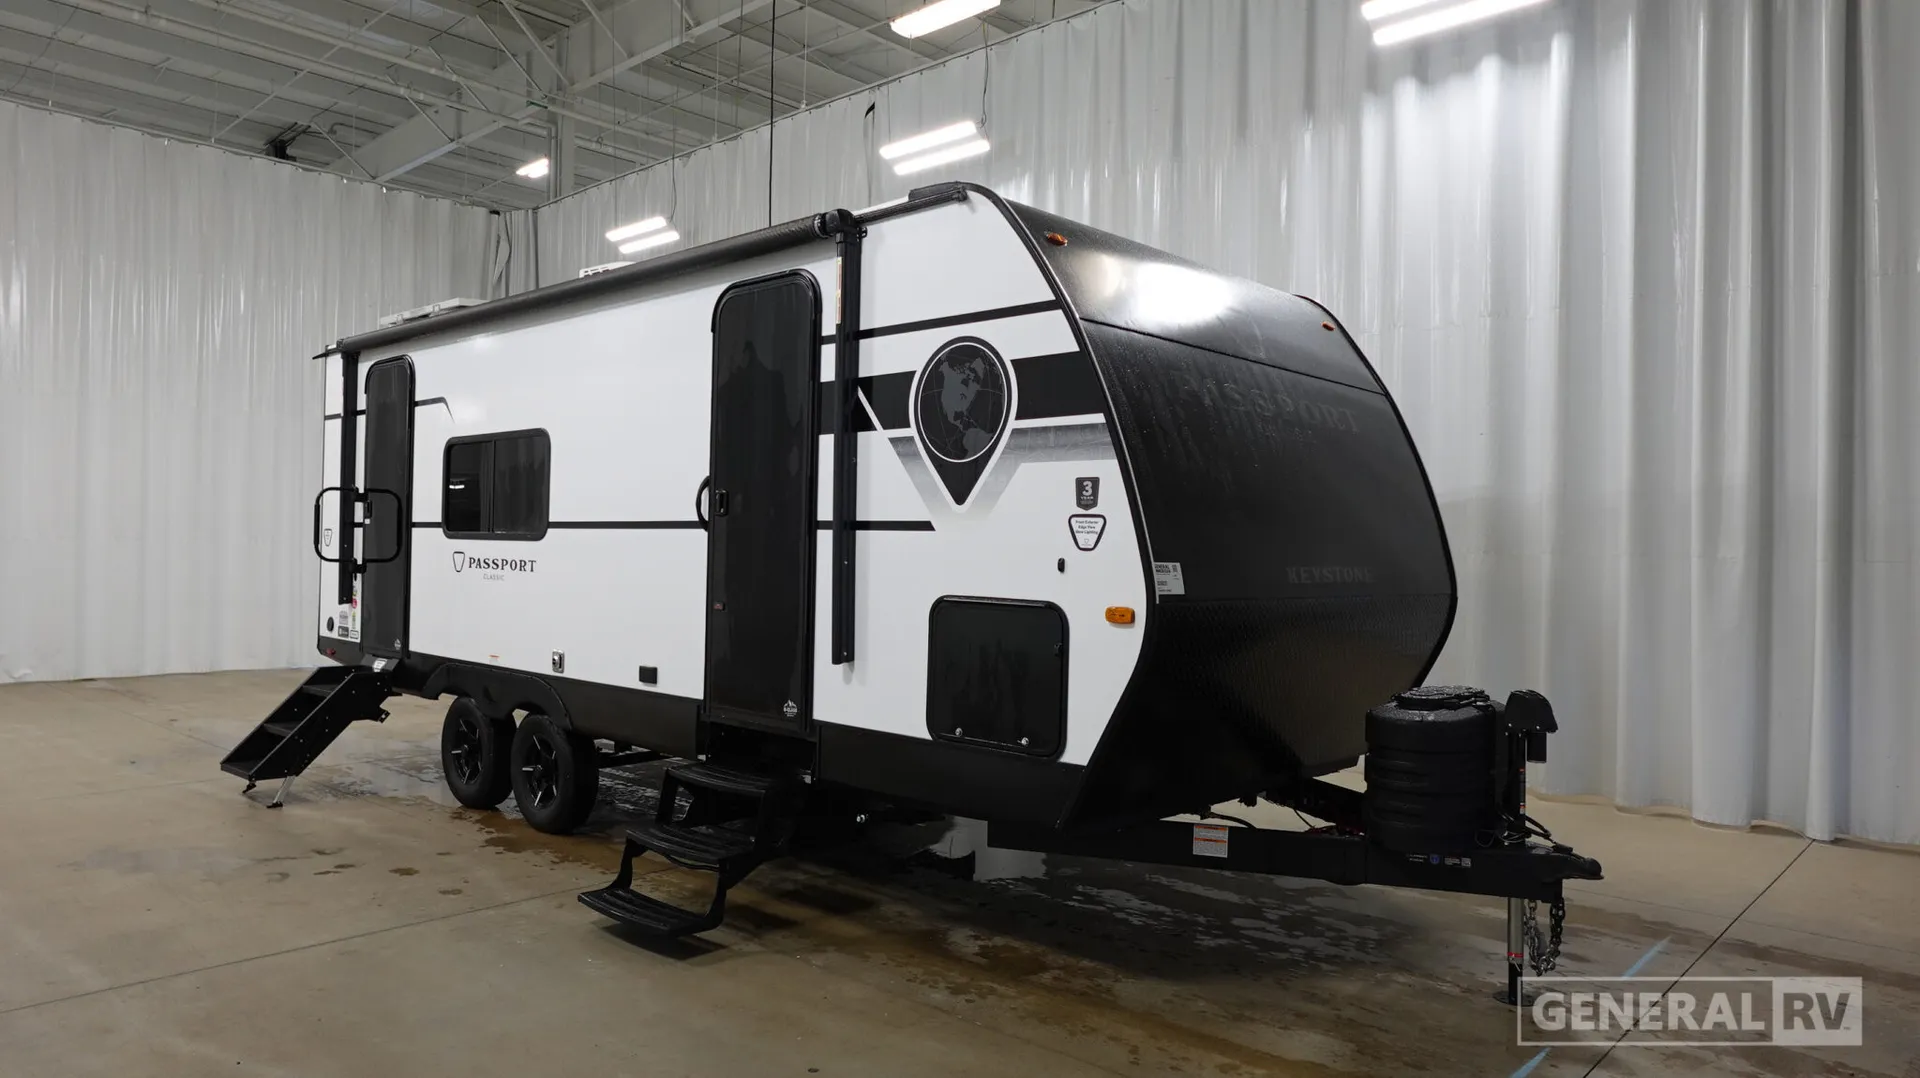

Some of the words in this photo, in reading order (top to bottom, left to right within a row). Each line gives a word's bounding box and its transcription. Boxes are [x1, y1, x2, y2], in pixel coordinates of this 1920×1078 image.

[1082, 480, 1093, 496] 3
[468, 557, 536, 572] PASSPORT
[483, 573, 505, 581] CLASSIC
[1286, 566, 1377, 584] KEYSTONE
